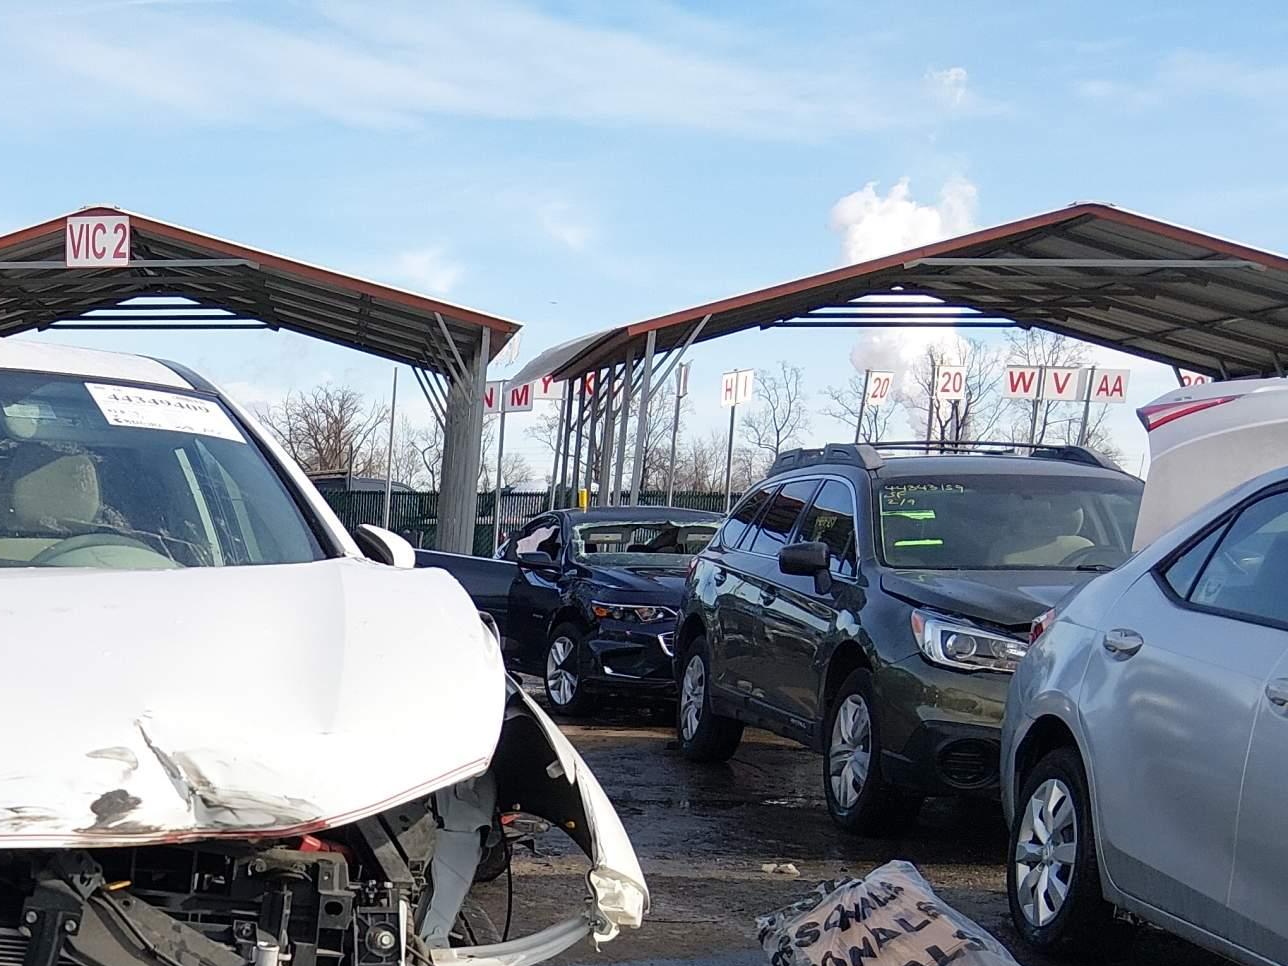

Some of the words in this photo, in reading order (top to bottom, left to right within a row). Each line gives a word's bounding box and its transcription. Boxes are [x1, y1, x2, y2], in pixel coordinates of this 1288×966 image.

[69, 223, 107, 259] VIC
[113, 223, 127, 258] 2
[540, 375, 553, 394] Y
[725, 378, 734, 400] H
[871, 377, 890, 398] 20
[940, 372, 963, 393] 20
[1009, 371, 1035, 394] W
[1053, 372, 1072, 394] V
[1095, 375, 1123, 397] AA
[511, 384, 529, 406] M
